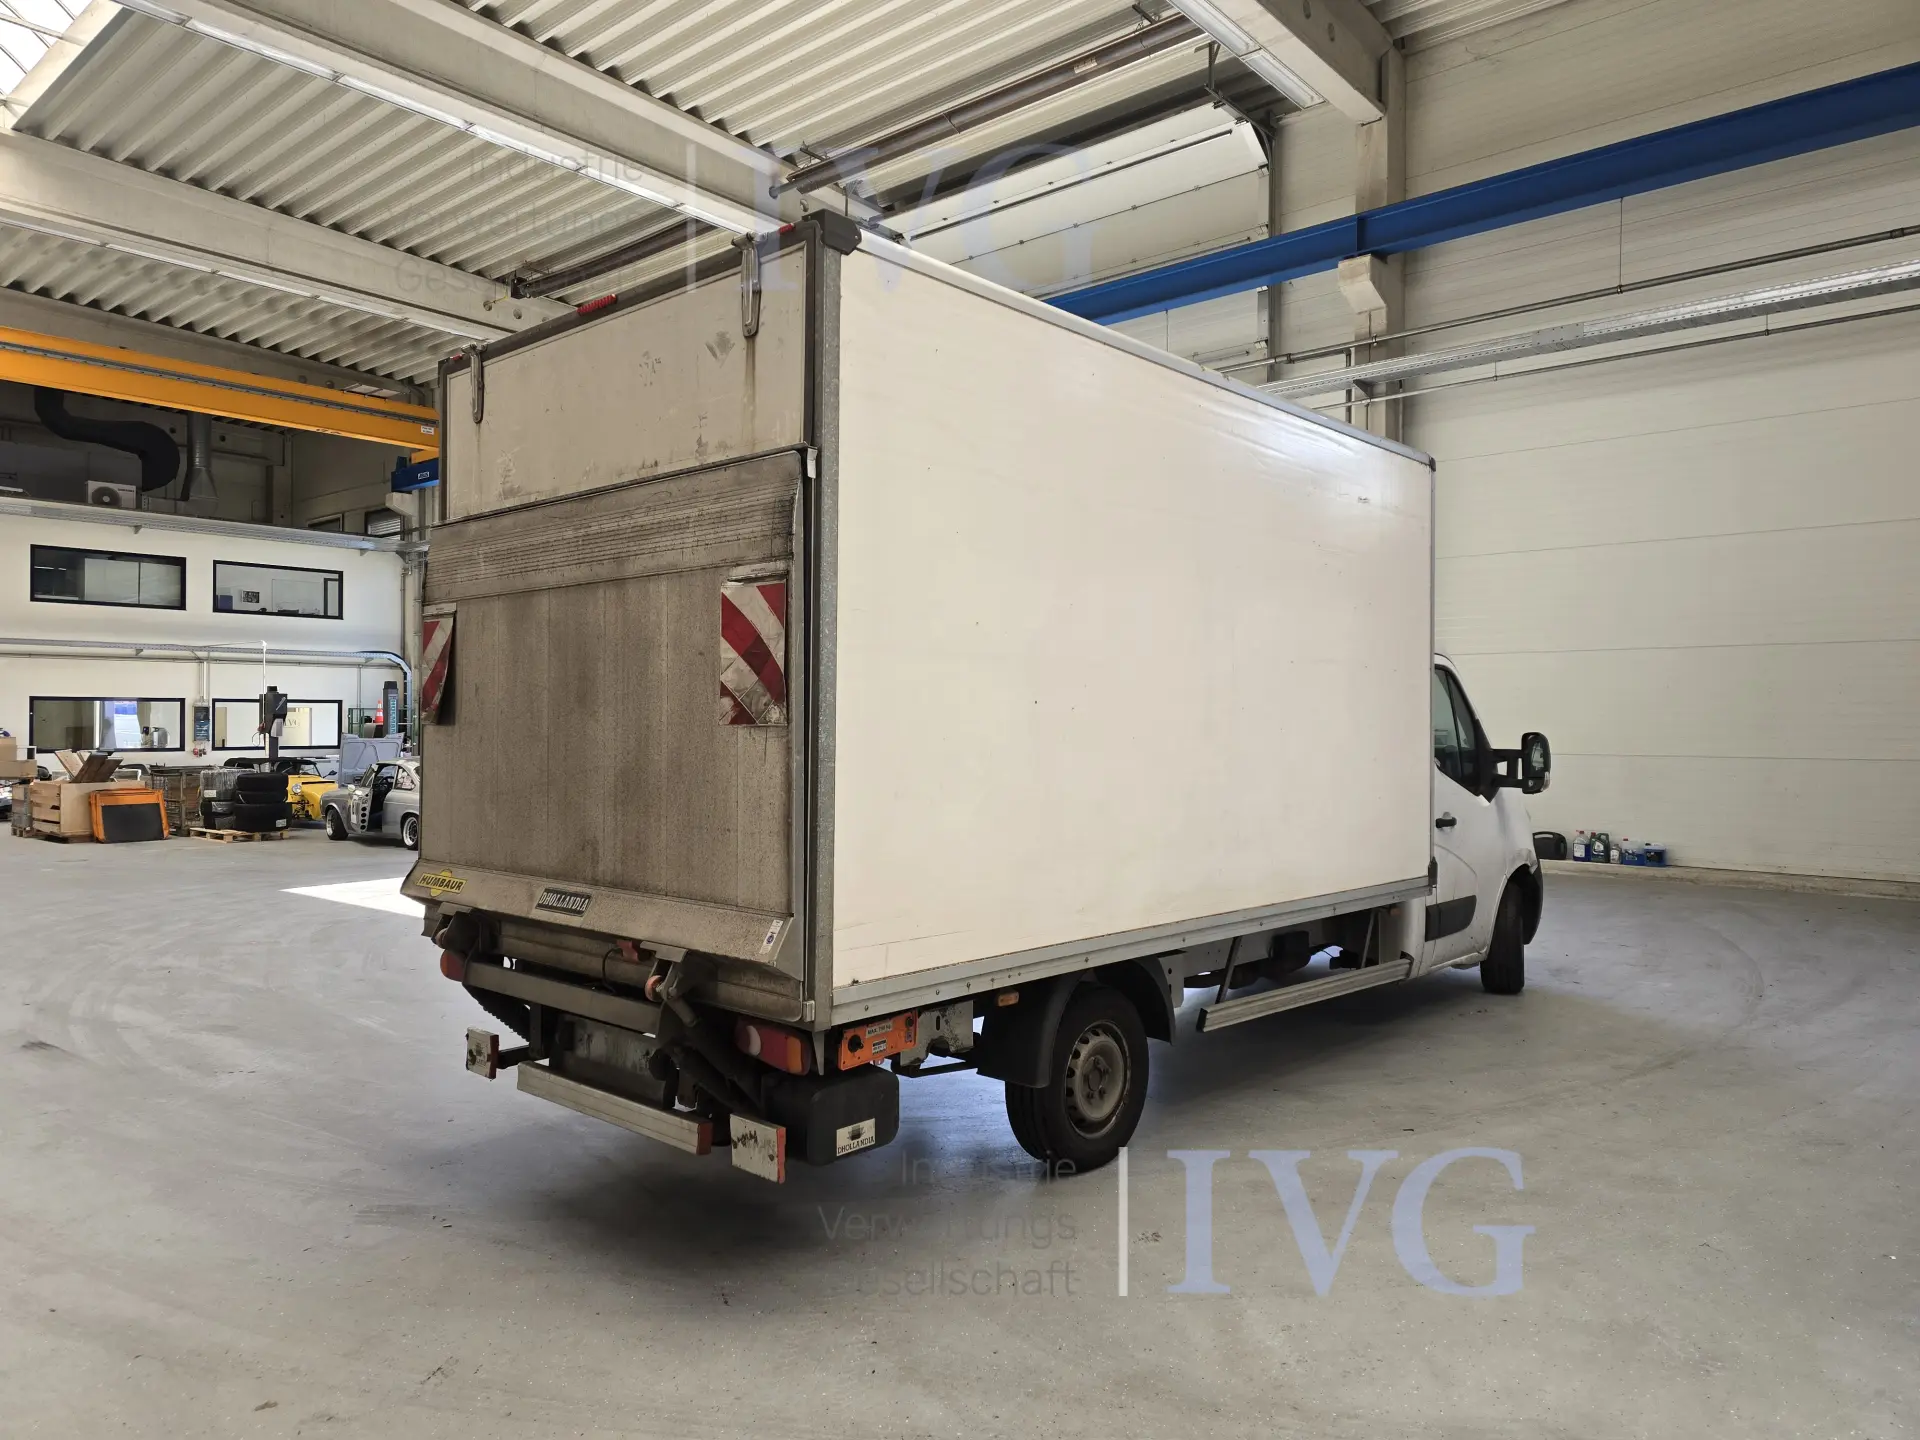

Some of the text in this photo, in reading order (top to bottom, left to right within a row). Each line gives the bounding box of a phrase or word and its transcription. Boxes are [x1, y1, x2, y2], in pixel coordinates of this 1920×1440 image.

[419, 874, 464, 891] HUMBAUR
[538, 891, 589, 912] DHOLLANDIA
[837, 1136, 875, 1154] DHOLLANDIA
